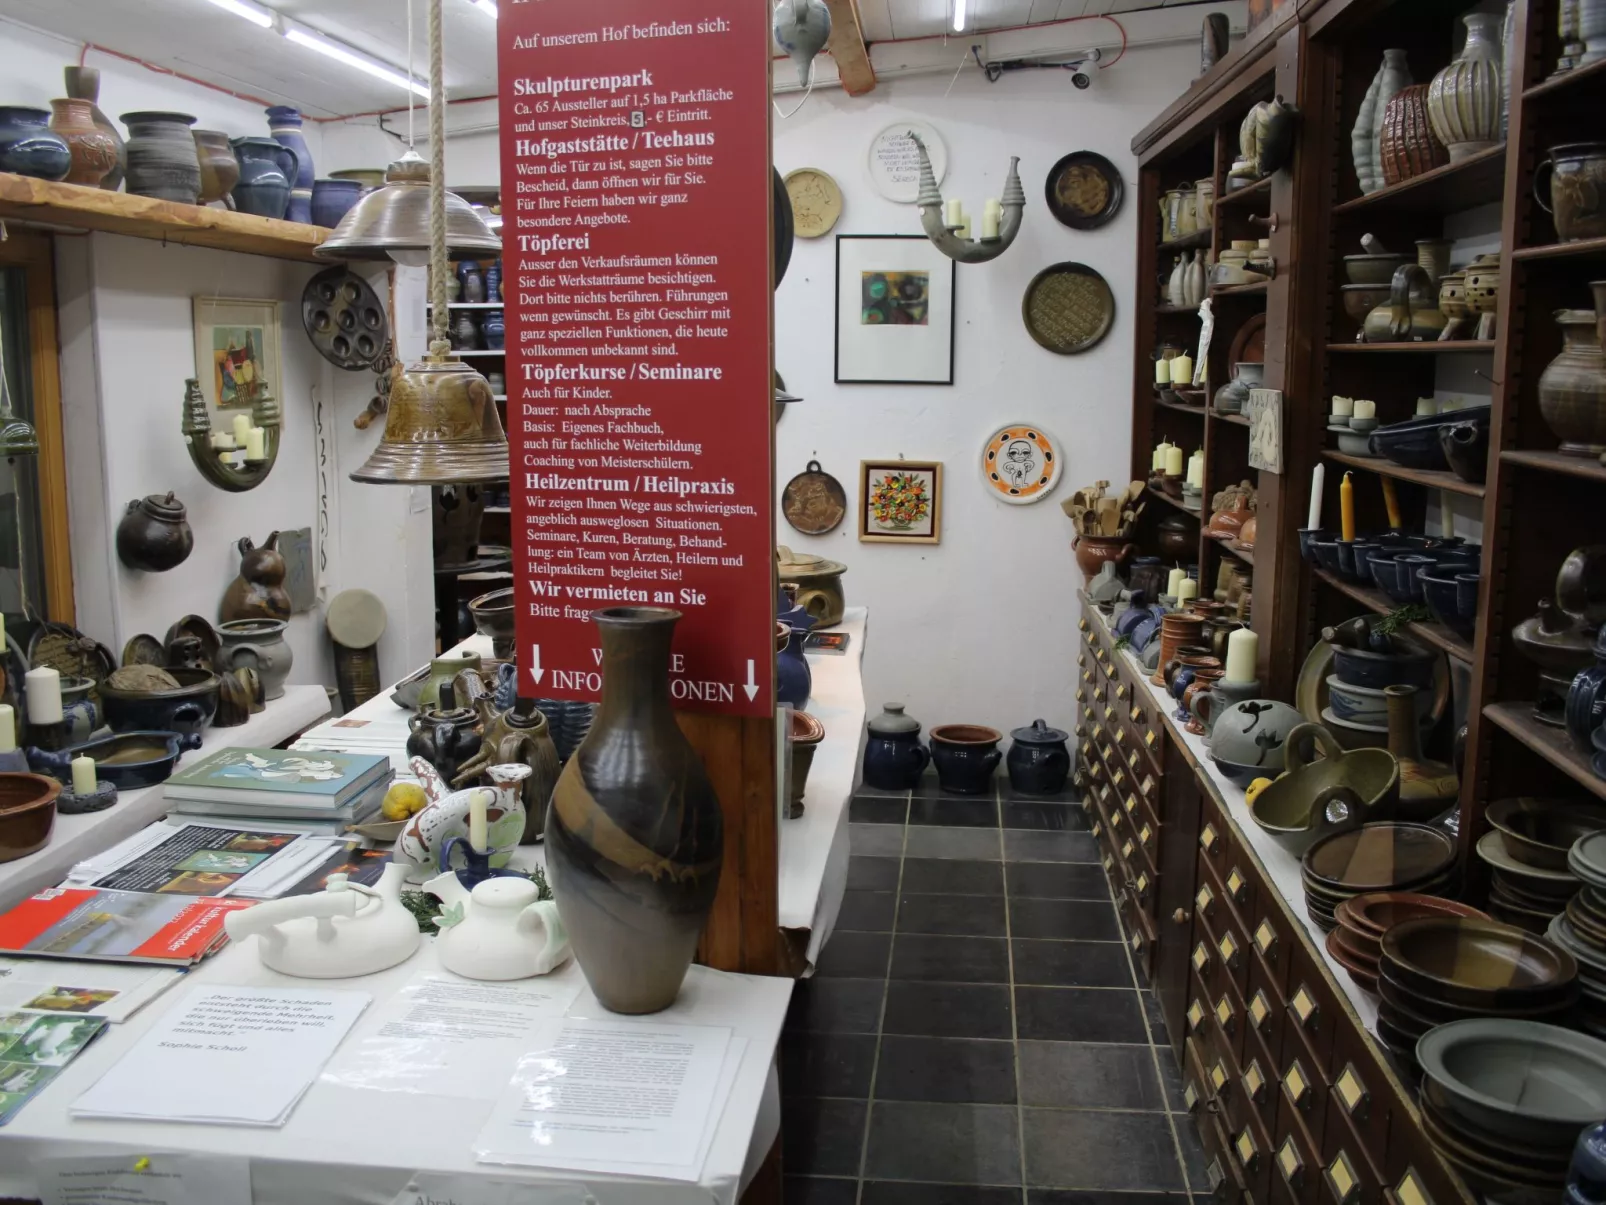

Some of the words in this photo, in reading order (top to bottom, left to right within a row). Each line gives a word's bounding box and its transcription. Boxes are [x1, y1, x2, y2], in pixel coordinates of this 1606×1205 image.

[512, 33, 540, 49] Auf
[541, 32, 598, 46] unserem
[602, 25, 630, 41] Hof
[632, 22, 692, 38] befinden
[696, 18, 730, 33] sich:
[513, 69, 652, 95] Skulpturenpark
[514, 102, 532, 114] Ca.
[535, 100, 548, 113] 65
[552, 97, 608, 111] Aussteller
[610, 94, 630, 107] auf
[633, 93, 650, 106] 1,5
[653, 92, 667, 104] ha
[670, 88, 733, 102] Parkfläche
[514, 119, 535, 132] und
[538, 120, 568, 130] unser
[655, 110, 663, 122] €
[667, 109, 711, 122] Eintritt.
[515, 135, 628, 156] Hofgaststätte
[641, 130, 714, 147] Teehaus
[515, 163, 546, 174] Wenn
[549, 161, 566, 173] die
[569, 160, 590, 171] Tür
[592, 162, 606, 170] zu
[609, 158, 626, 169] ist,
[629, 158, 661, 171] sagen
[665, 154, 683, 166] Sie
[686, 154, 713, 165] bitte
[516, 179, 569, 192] Bescheid,
[571, 178, 599, 189] dann
[601, 175, 638, 188] öffnen
[641, 174, 661, 185] wir
[664, 173, 681, 185] für
[684, 172, 706, 184] Sie.
[516, 198, 536, 210] Für
[539, 197, 560, 208] Ihre
[563, 196, 598, 207] Feiern
[601, 194, 635, 205] haben
[638, 192, 657, 204] wir
[660, 193, 688, 206] ganz
[516, 215, 571, 227] besondere
[574, 213, 630, 227] Angebote.
[517, 233, 589, 254] Töpferei
[518, 259, 556, 270] Ausser
[558, 257, 578, 268] den
[580, 255, 672, 267] Verkaufsräumen
[675, 253, 718, 265] können
[518, 275, 536, 287] Sie
[538, 275, 555, 287] die
[558, 274, 644, 285] Werkstatträume
[647, 272, 716, 285] besichtigen.
[519, 292, 544, 304] Dort
[546, 292, 570, 304] bitte
[573, 291, 606, 303] nichts
[609, 290, 662, 302] berühren.
[666, 289, 728, 303] Führungen
[519, 313, 548, 321] wenn
[551, 309, 612, 324] gewünscht.
[616, 308, 630, 320] Es
[633, 308, 655, 322] gibt
[658, 307, 708, 319] Geschirr
[711, 306, 730, 318] mit
[520, 330, 545, 342] ganz
[548, 327, 602, 340] speziellen
[605, 326, 672, 337] Funktionen,
[674, 325, 693, 337] die
[696, 325, 728, 337] heute
[520, 344, 588, 355] vollkommen
[591, 344, 648, 355] unbekannt
[651, 343, 678, 355] sind.
[520, 363, 626, 382] Töpferkurse
[638, 363, 722, 379] Seminare
[522, 386, 550, 398] Auch
[554, 386, 570, 398] für
[572, 386, 612, 398] Kinder.
[522, 403, 558, 415] Dauer:
[564, 404, 590, 415] nach
[592, 404, 651, 418] Absprache
[523, 420, 555, 432] Basis:
[562, 421, 604, 434] Eigenes
[607, 421, 664, 434] Fachbuch,
[523, 437, 548, 448] auch
[551, 437, 567, 449] für
[570, 438, 619, 450] fachliche
[622, 439, 702, 454] Weiterbildung
[523, 454, 575, 469] Coaching
[577, 458, 598, 466] von
[601, 456, 693, 469] Meisterschülern.
[525, 473, 629, 490] Heilzentrum
[644, 476, 734, 496] Heilpraxis
[525, 495, 546, 507] Wir
[548, 497, 583, 510] zeigen
[586, 497, 616, 509] Ihnen
[619, 498, 650, 513] Wege
[653, 502, 672, 511] aus
[675, 501, 757, 516] schwierigsten,
[526, 513, 577, 526] angeblich
[580, 516, 649, 529] ausweglosen
[655, 516, 722, 530] Situationen.
[526, 528, 579, 542] Seminare,
[582, 531, 619, 544] Kuren,
[622, 532, 676, 549] Beratung,
[679, 535, 727, 548] Behand-
[527, 545, 554, 559] lung:
[556, 546, 573, 557] ein
[576, 547, 606, 559] Team
[608, 551, 629, 560] von
[632, 548, 672, 563] Ärzten,
[676, 552, 718, 565] Heilern
[721, 554, 743, 566] und
[528, 562, 604, 576] Heilpraktikern
[610, 566, 657, 580] begleitet
[660, 568, 682, 580] Sie!
[528, 580, 561, 596] Wir
[565, 585, 648, 601] vermieten
[653, 591, 674, 603] an
[680, 588, 706, 605] Sie
[530, 604, 560, 617] Bitte
[254, 1003, 290, 1012] durch
[281, 998, 332, 1006] Schaden
[233, 1016, 298, 1026] überleben
[157, 1041, 203, 1050] Sophie
[206, 1044, 248, 1052] Scholl
